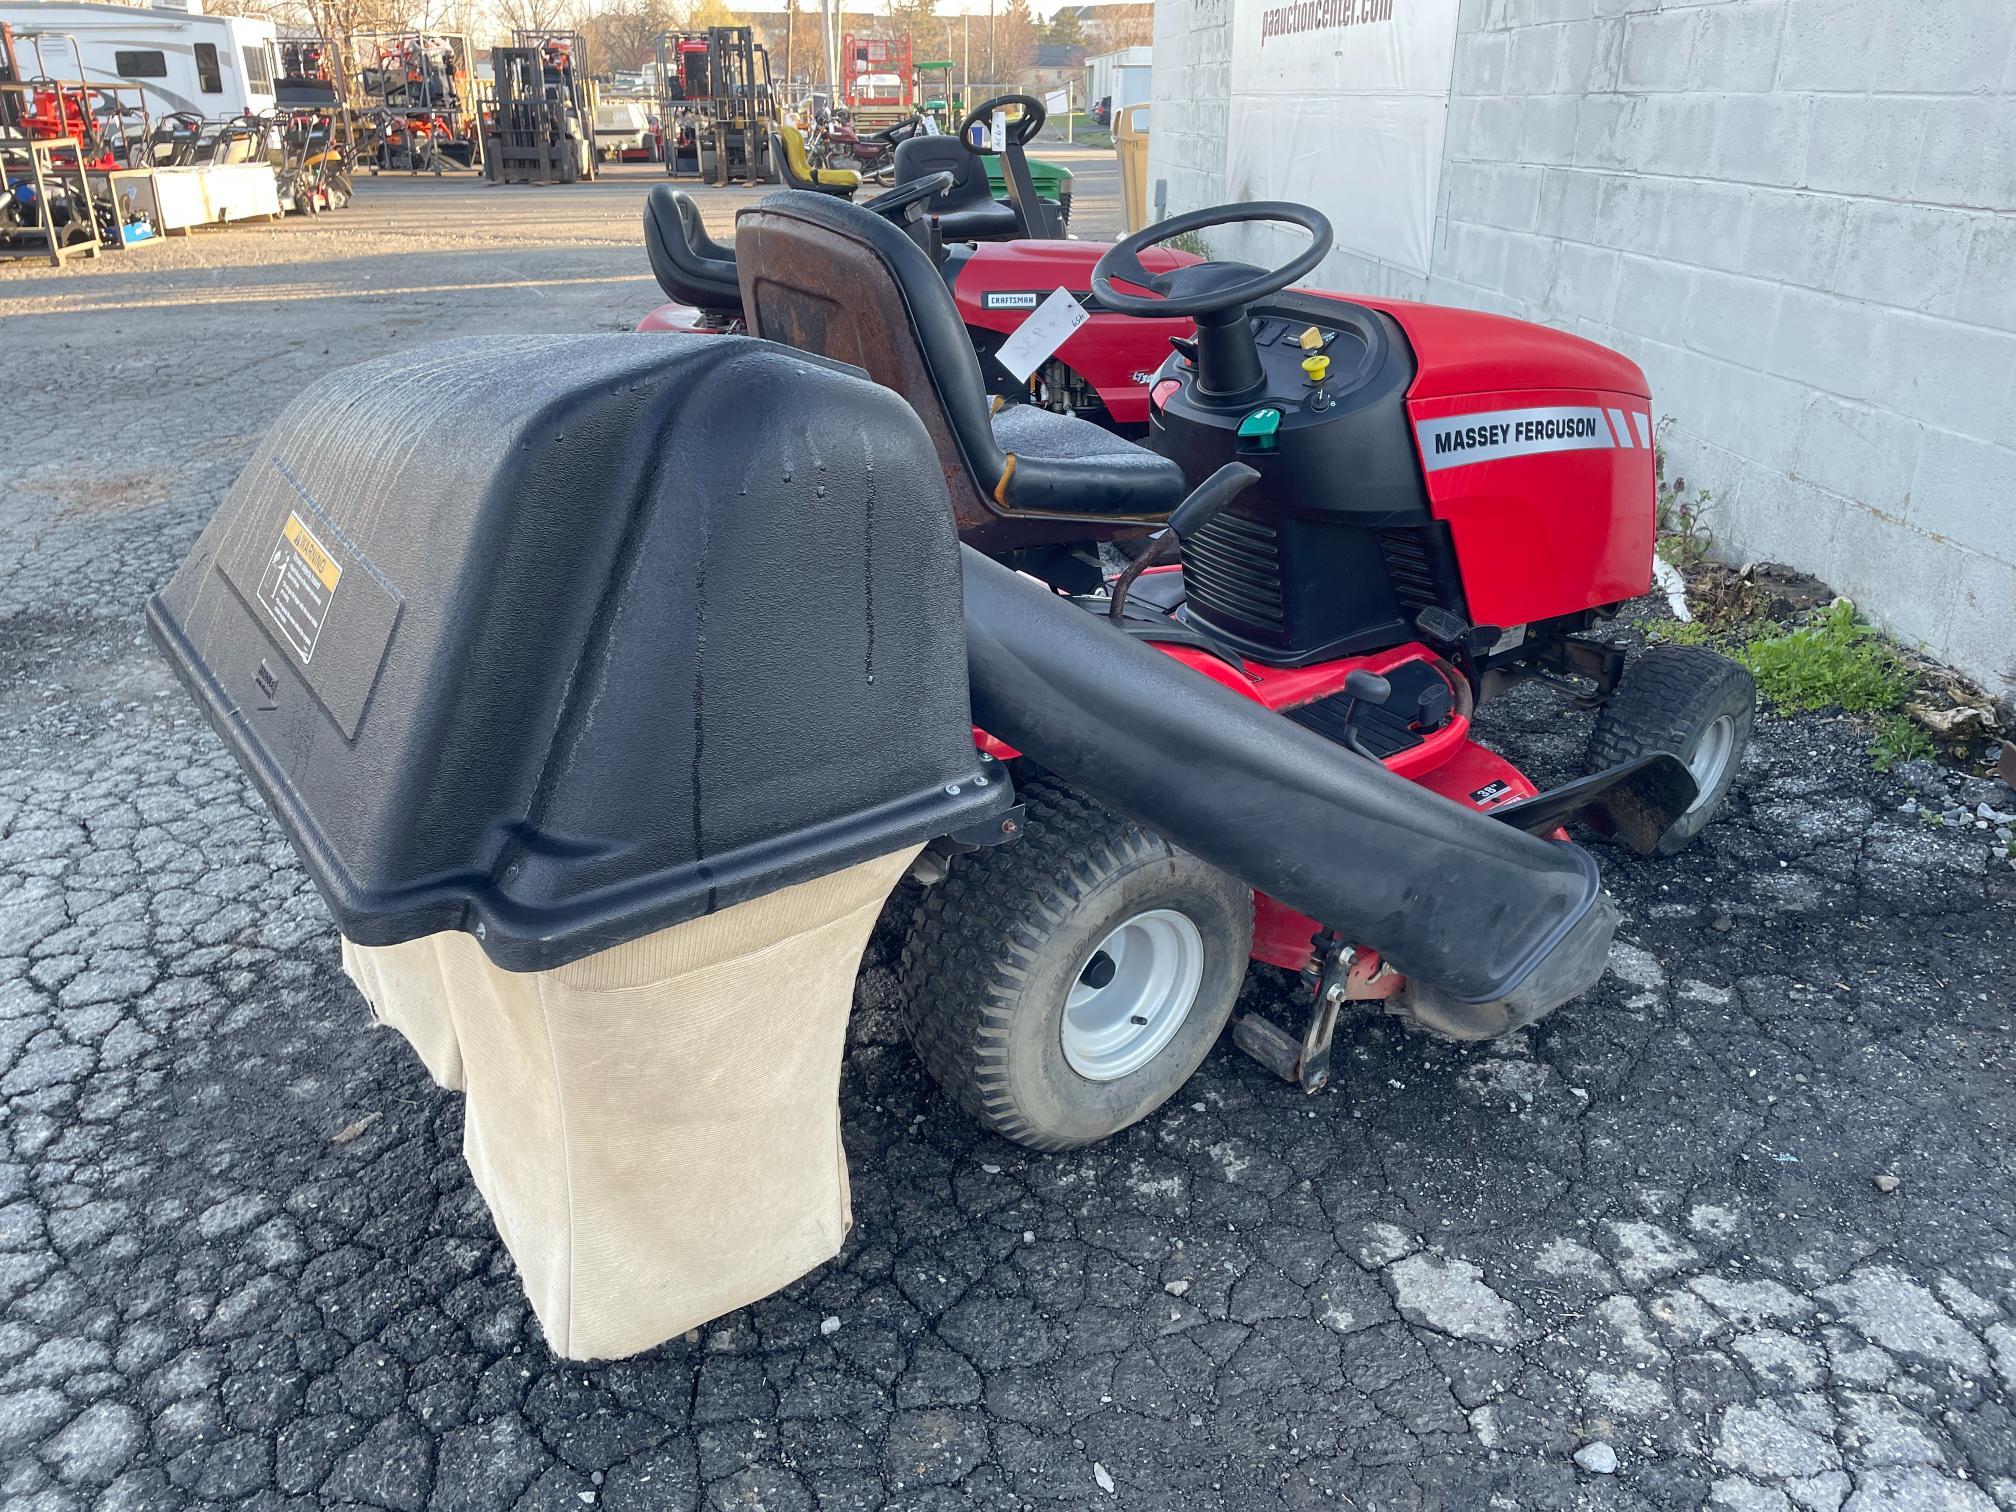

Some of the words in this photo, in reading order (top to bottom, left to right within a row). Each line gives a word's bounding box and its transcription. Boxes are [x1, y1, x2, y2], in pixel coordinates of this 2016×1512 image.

[1261, 0, 1393, 47] paauctioncenter.com
[991, 296, 1034, 304] CRAFTSMAN
[1434, 423, 1510, 454] MASSEY
[1515, 417, 1597, 442] FERGUSON
[299, 534, 327, 574] WARNING
[1476, 783, 1498, 797] 38"
